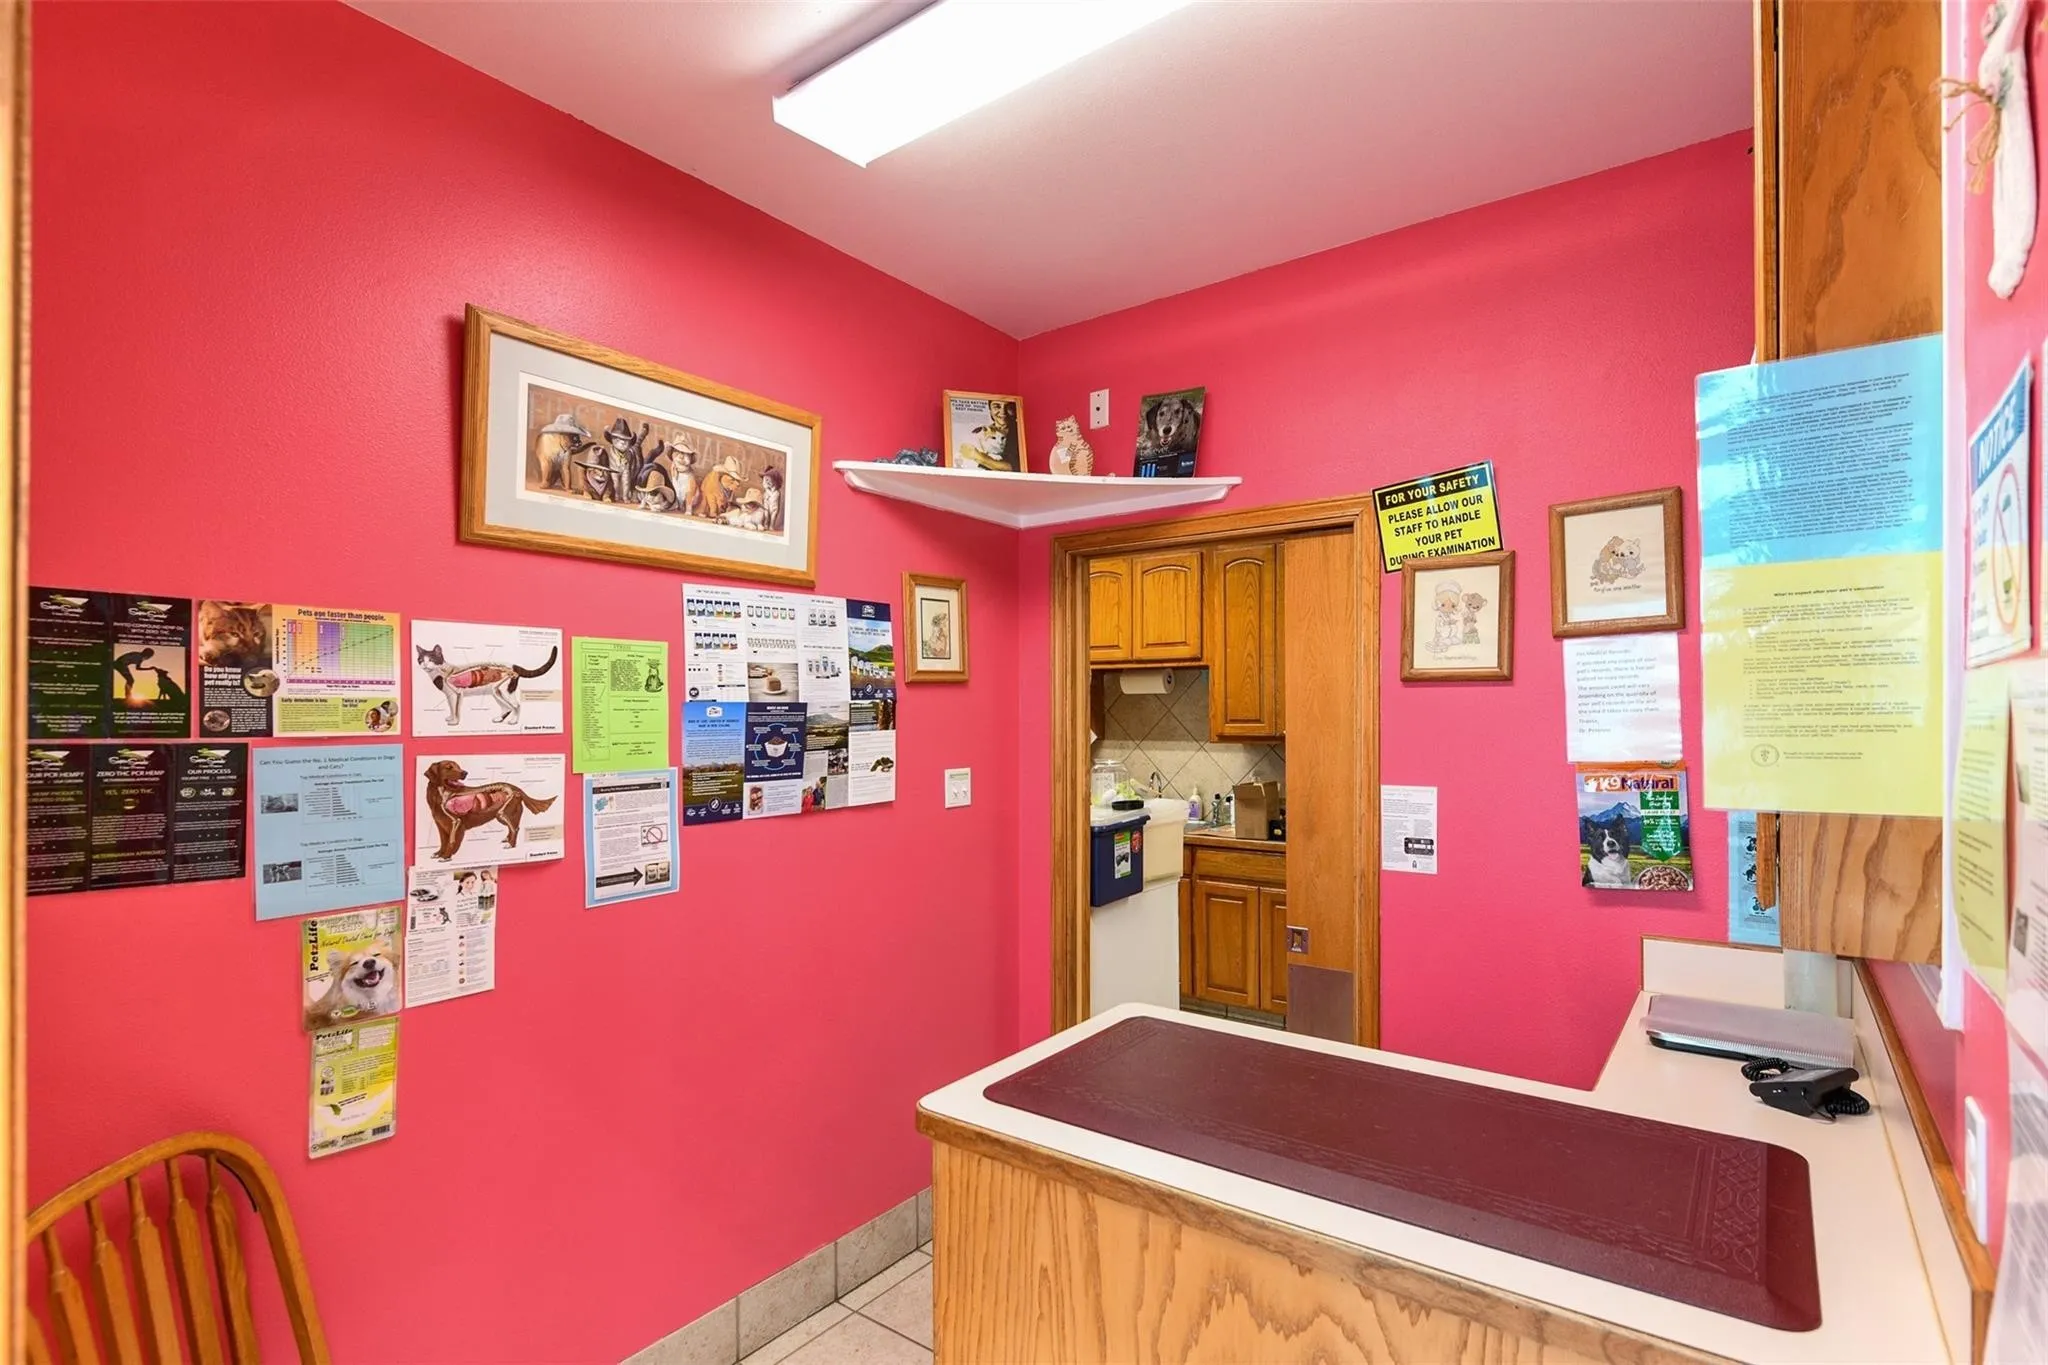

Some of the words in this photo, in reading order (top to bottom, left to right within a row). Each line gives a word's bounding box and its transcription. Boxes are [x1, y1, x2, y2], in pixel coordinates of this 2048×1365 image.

[1386, 494, 1405, 506] FOR
[1408, 485, 1436, 500] YOUR
[1439, 474, 1479, 492] SAFETY
[1388, 508, 1423, 524] PLEASE
[1426, 500, 1458, 515] ALLOW
[1462, 495, 1483, 507] OUR
[1394, 523, 1422, 536] STAFF
[1426, 520, 1438, 529] TO
[1442, 510, 1480, 526] HANDLE
[1415, 534, 1442, 546] YOUR
[1445, 529, 1462, 540] PET
[1428, 536, 1495, 558] EXAMINATION
[309, 920, 319, 972] PetzLife
